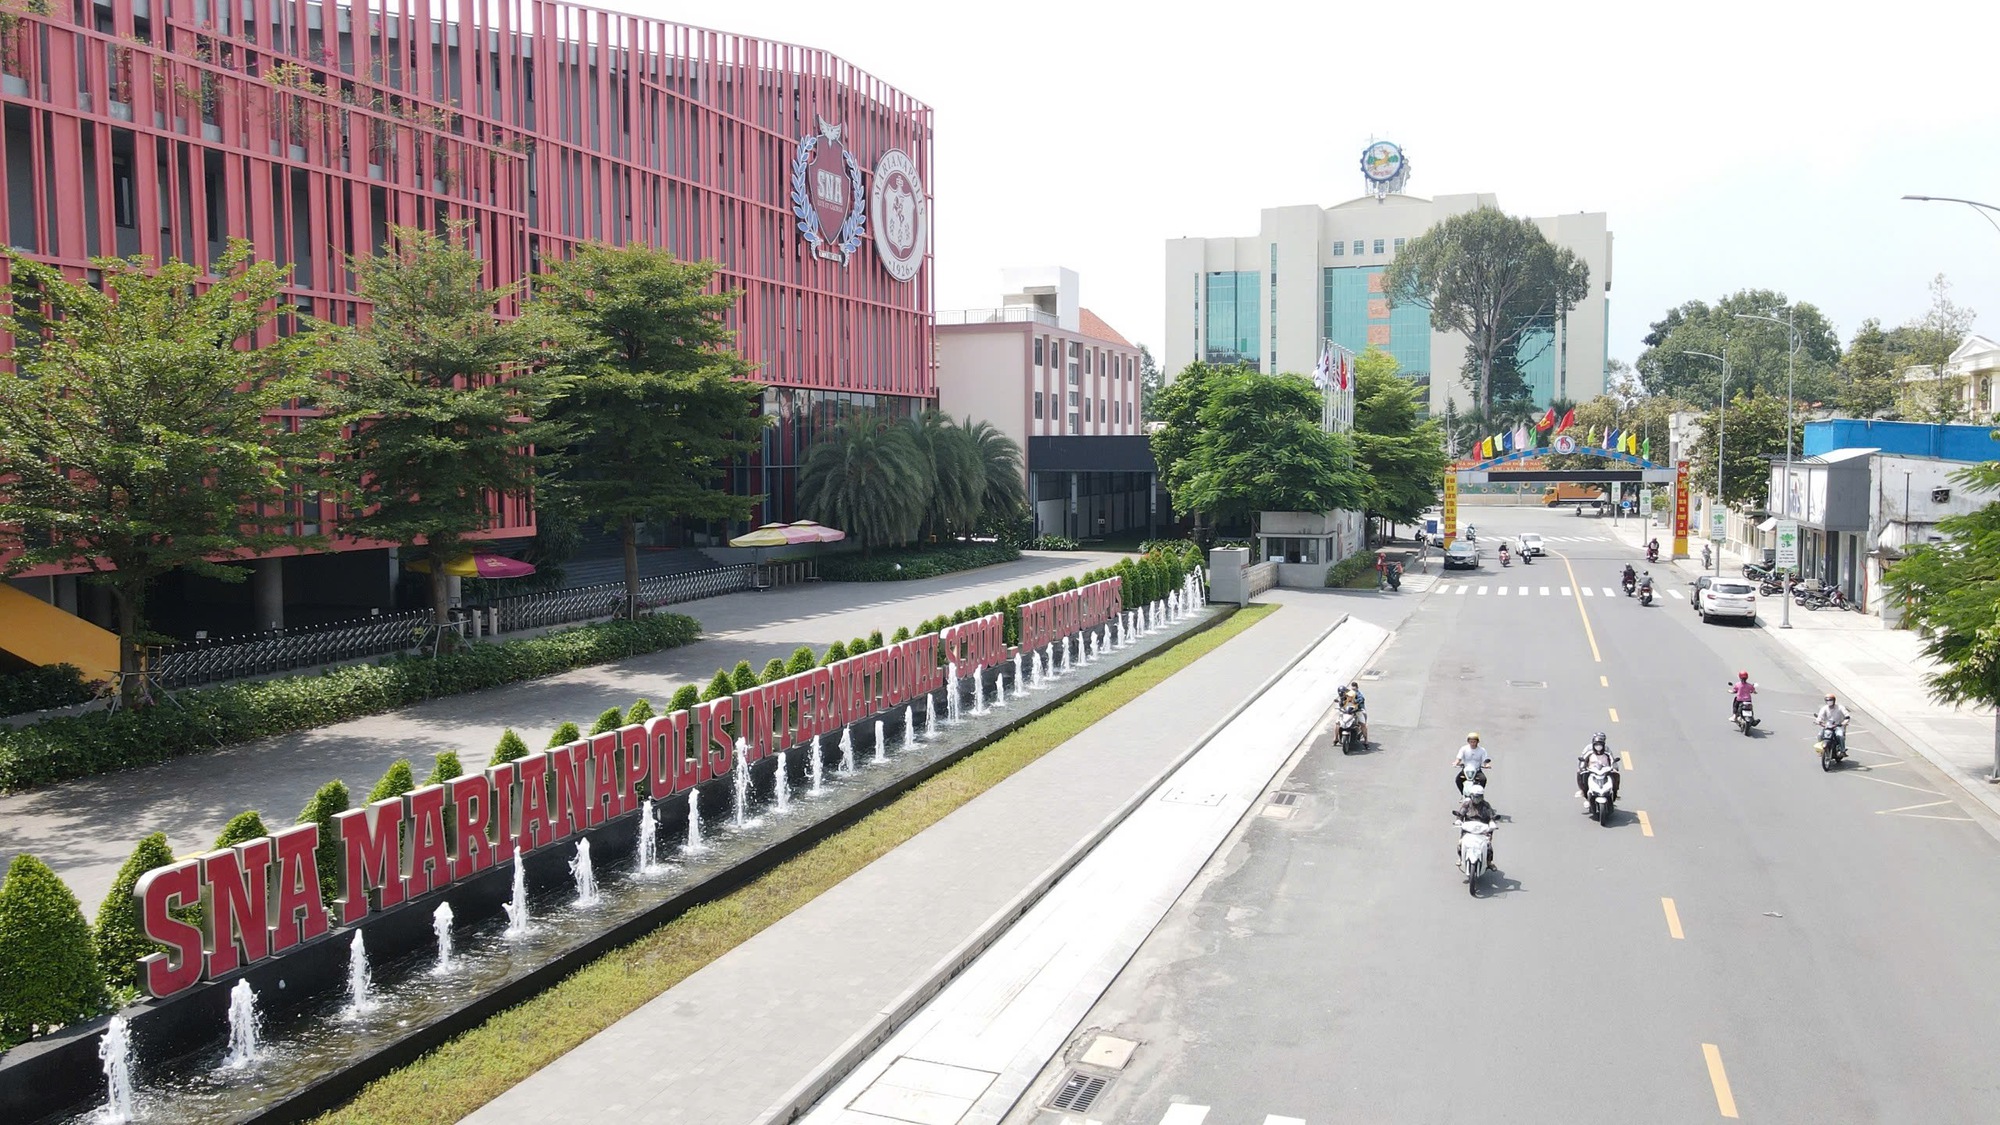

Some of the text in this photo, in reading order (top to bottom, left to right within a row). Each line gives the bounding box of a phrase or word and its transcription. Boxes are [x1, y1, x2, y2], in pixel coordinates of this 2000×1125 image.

[817, 169, 843, 205] SNA
[874, 155, 924, 216] MARIANAPOLIS
[891, 261, 911, 277] 1926
[133, 823, 329, 998] SNA
[332, 696, 733, 926] MARIANAPOLIS
[733, 632, 943, 763] INTERNATIONAL
[940, 612, 1007, 680] SCHOOL
[1079, 575, 1121, 632] CAMPUS
